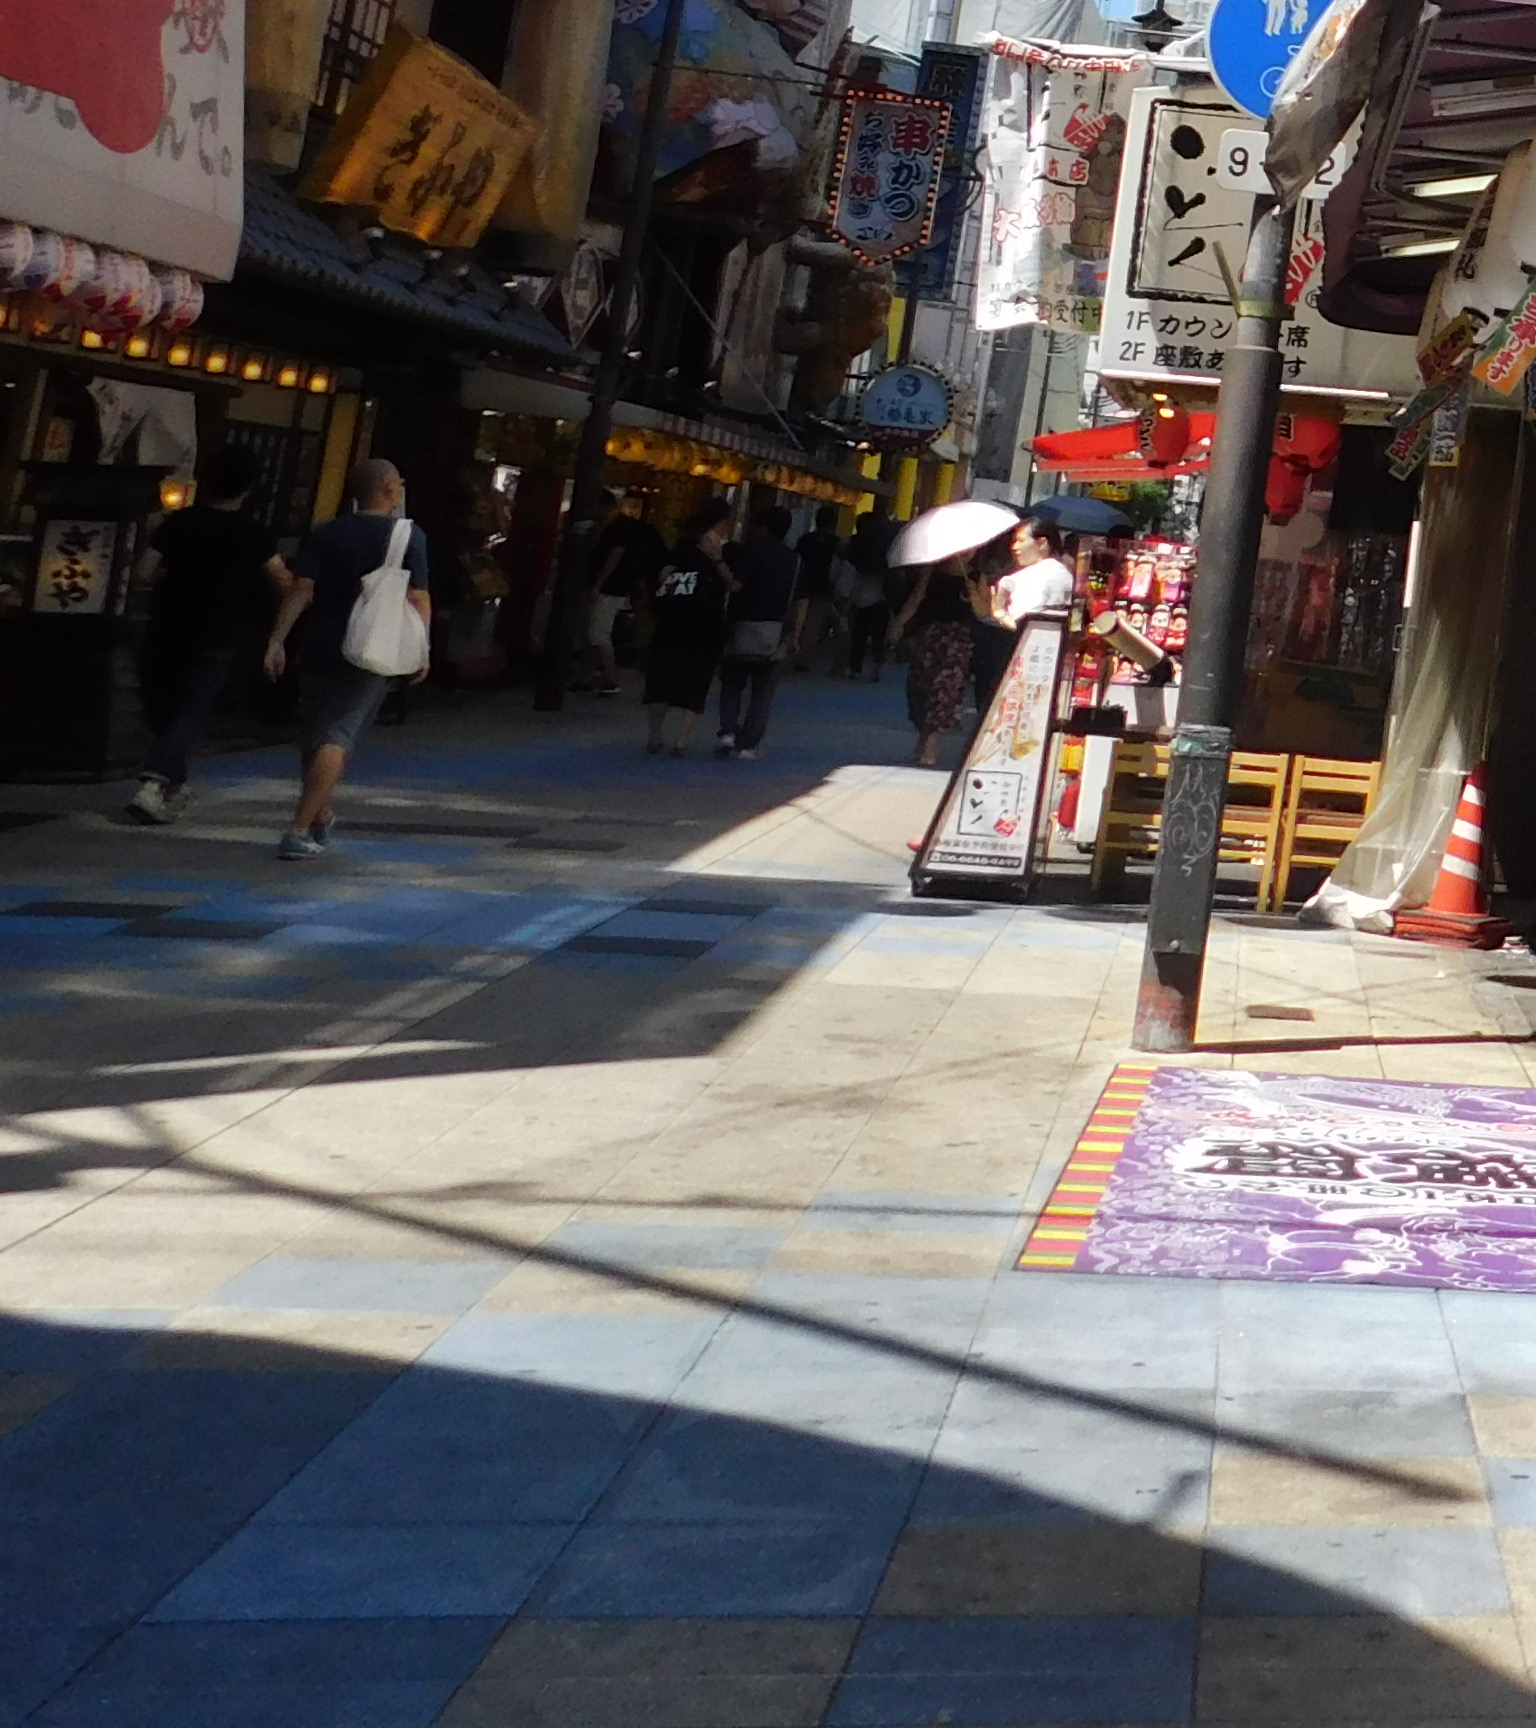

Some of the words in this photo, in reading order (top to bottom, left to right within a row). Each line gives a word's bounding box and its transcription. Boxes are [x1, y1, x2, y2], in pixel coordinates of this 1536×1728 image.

[882, 113, 933, 220] 串かつ
[1127, 312, 1150, 330] 1F
[1119, 343, 1145, 361] 2F
